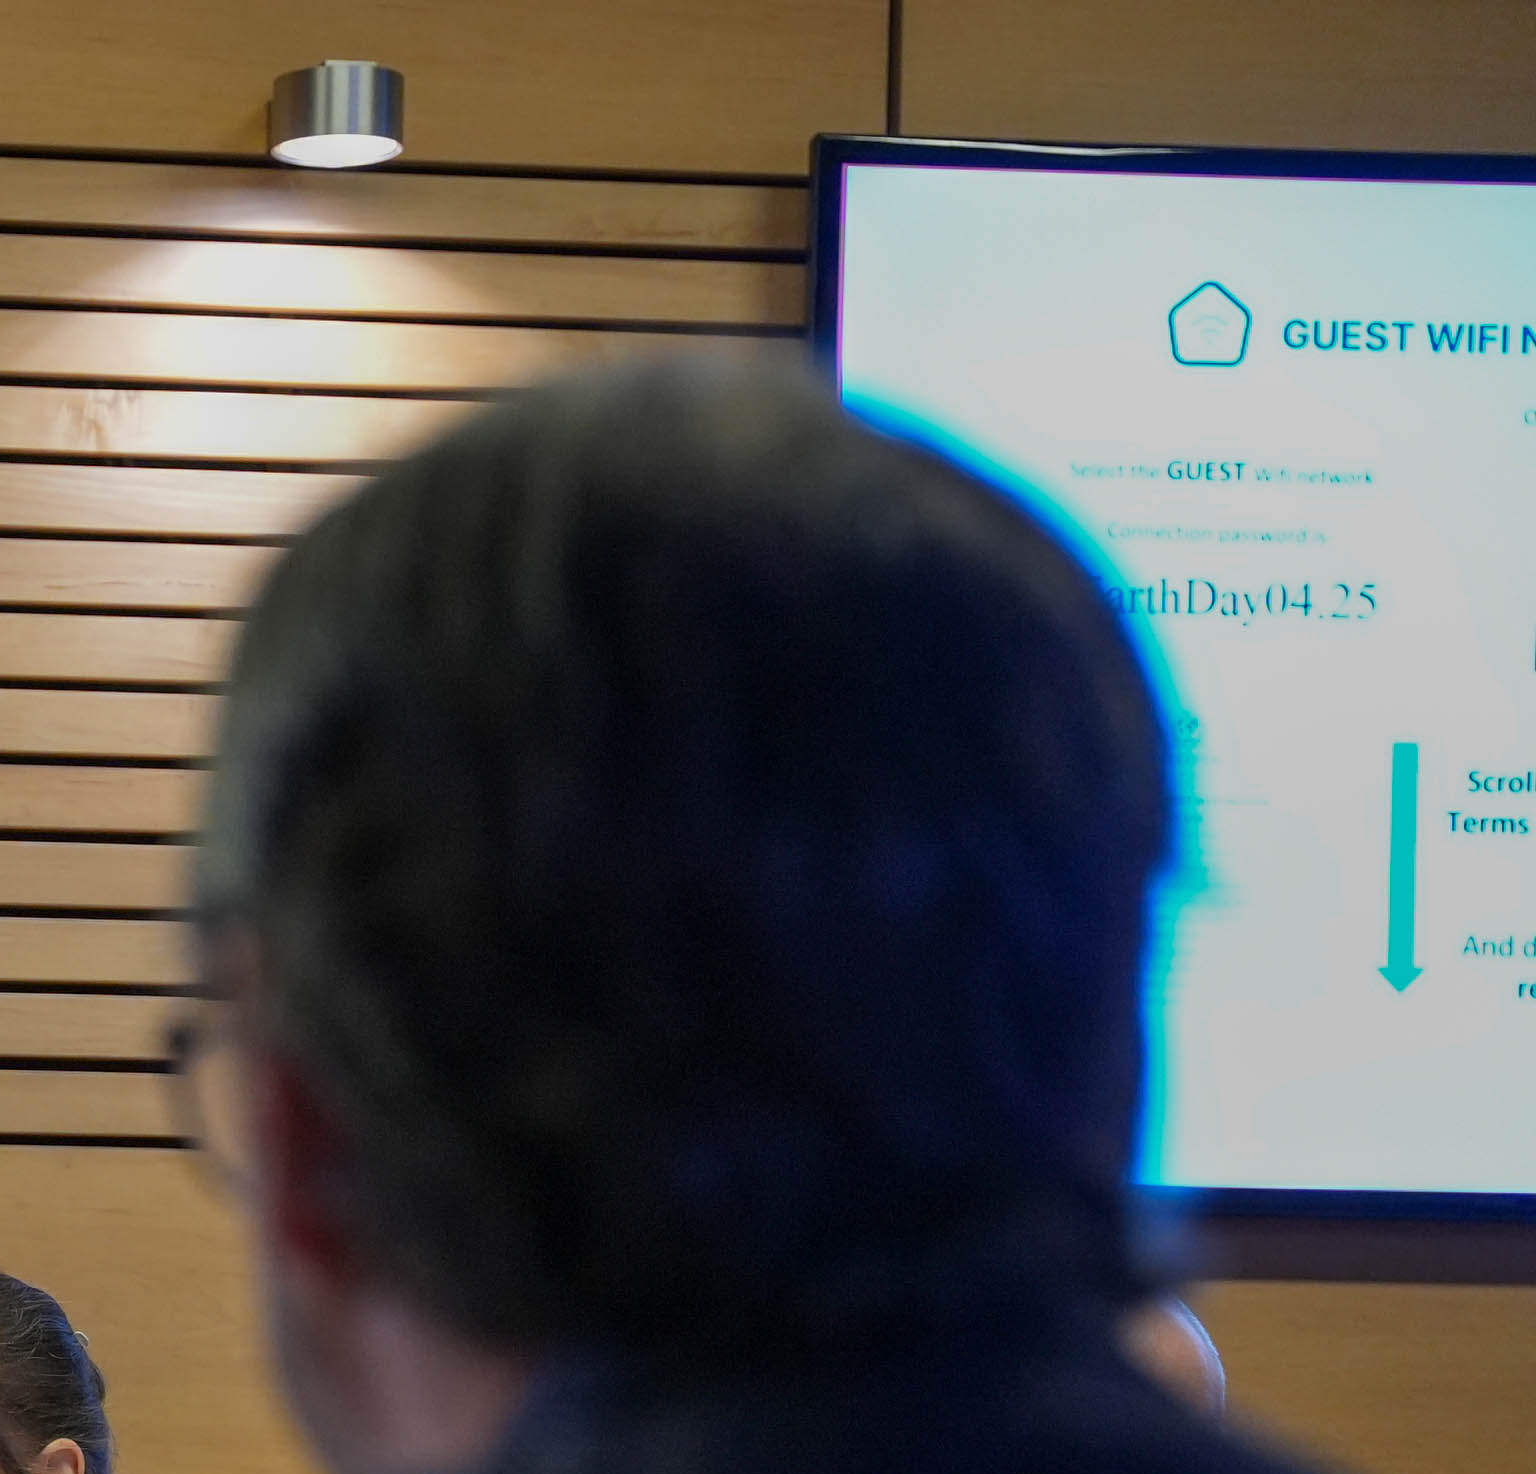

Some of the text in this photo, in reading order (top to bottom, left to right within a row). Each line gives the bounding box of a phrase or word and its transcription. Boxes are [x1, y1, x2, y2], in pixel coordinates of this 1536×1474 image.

[1283, 319, 1415, 352] GUEST
[1426, 323, 1511, 355] WIFI
[1167, 460, 1247, 481] GUEST
[1091, 577, 1376, 627] arthDay04.25
[1468, 769, 1536, 793] Scrol
[1448, 810, 1530, 834] Terms
[1463, 935, 1514, 957] And
